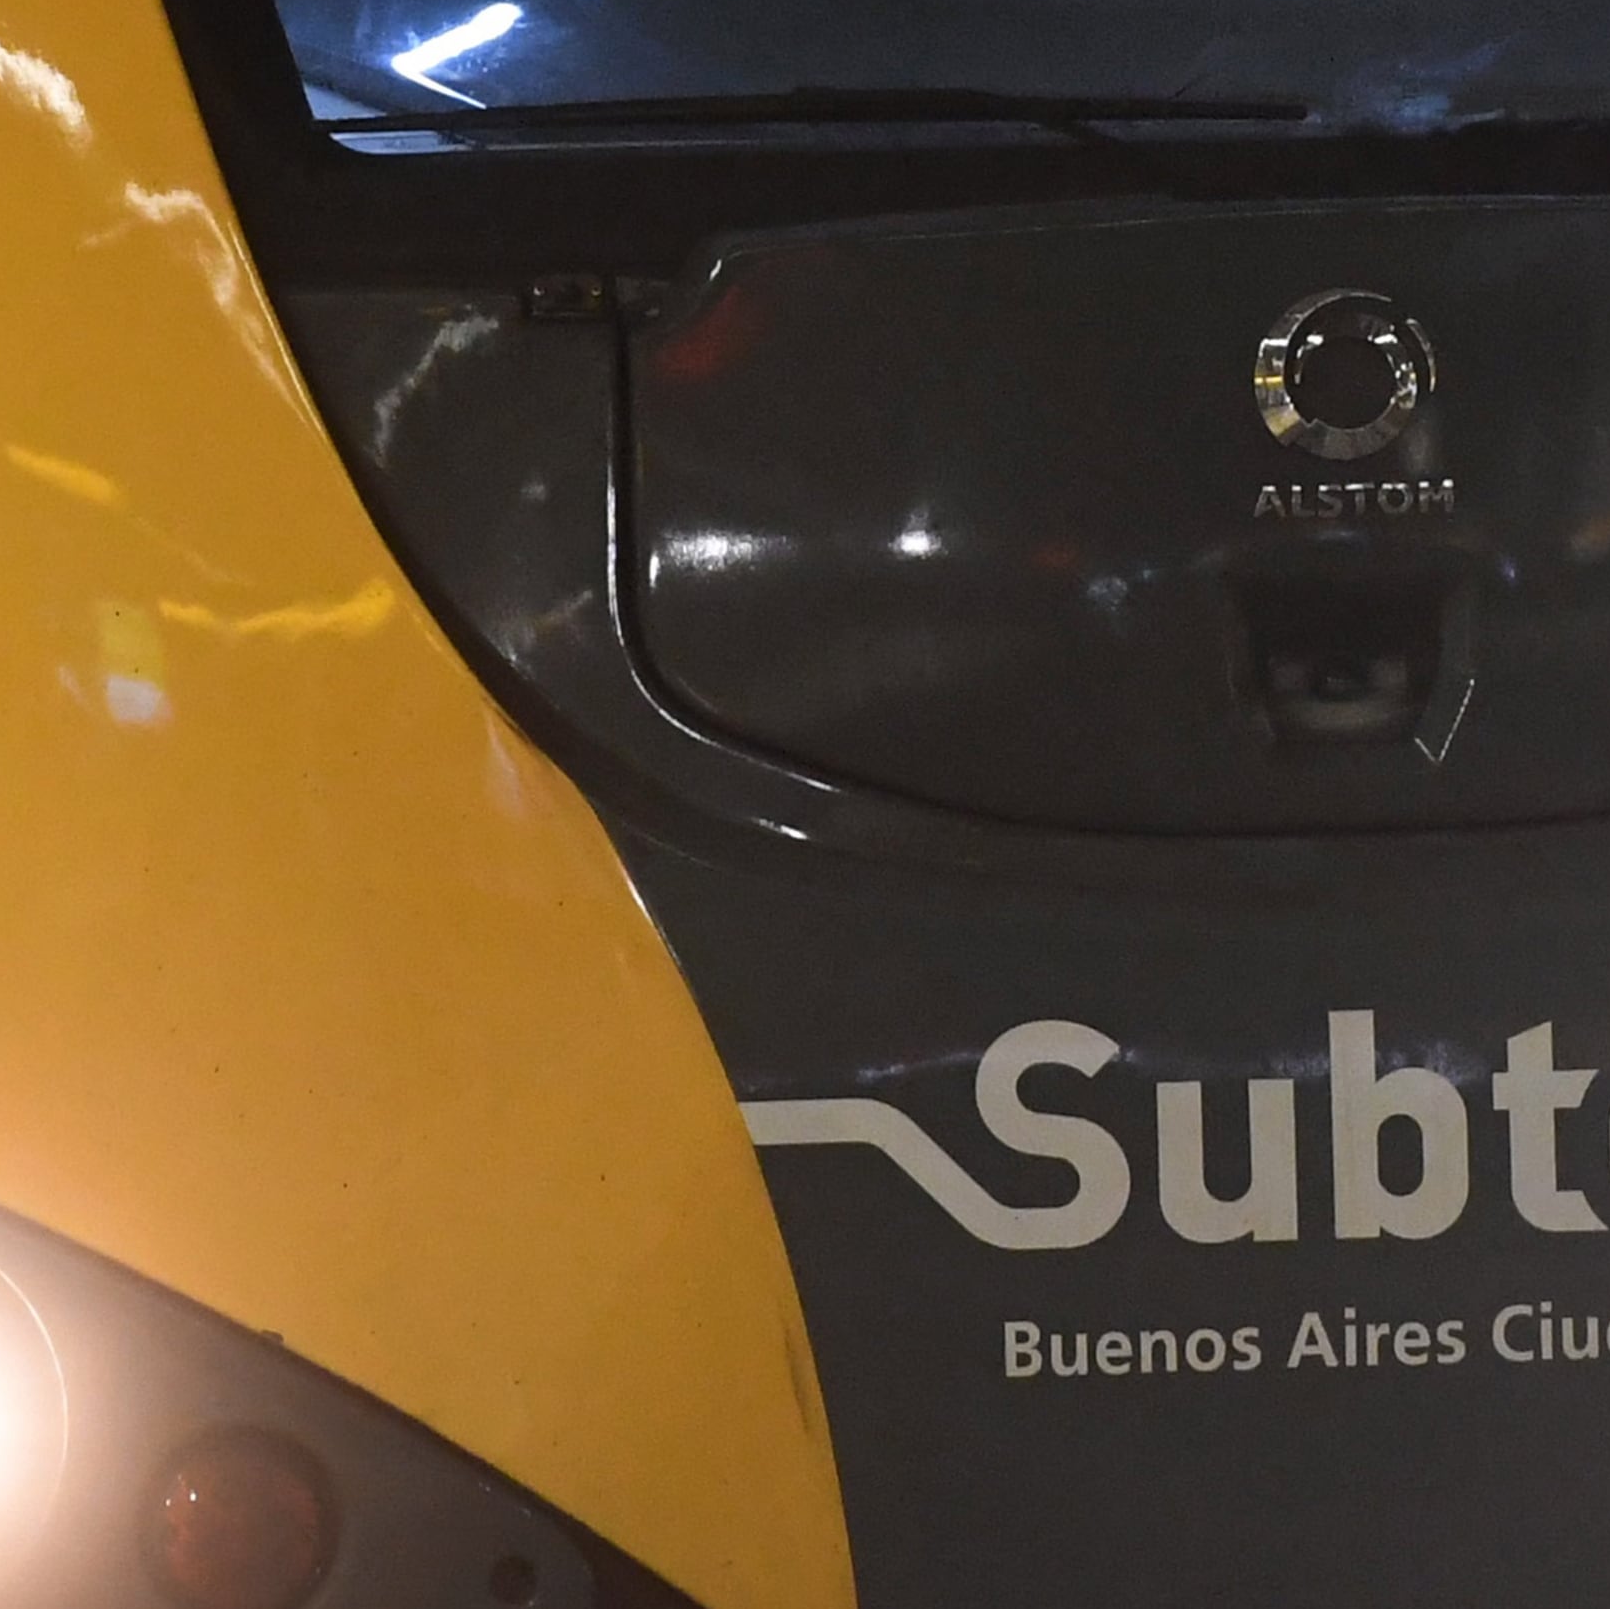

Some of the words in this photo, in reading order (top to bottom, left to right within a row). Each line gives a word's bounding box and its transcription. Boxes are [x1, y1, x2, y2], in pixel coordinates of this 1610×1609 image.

[1253, 478, 1455, 518] ALSTOM
[1003, 1320, 1262, 1379] Buenos
[1286, 1307, 1467, 1369] Aires
